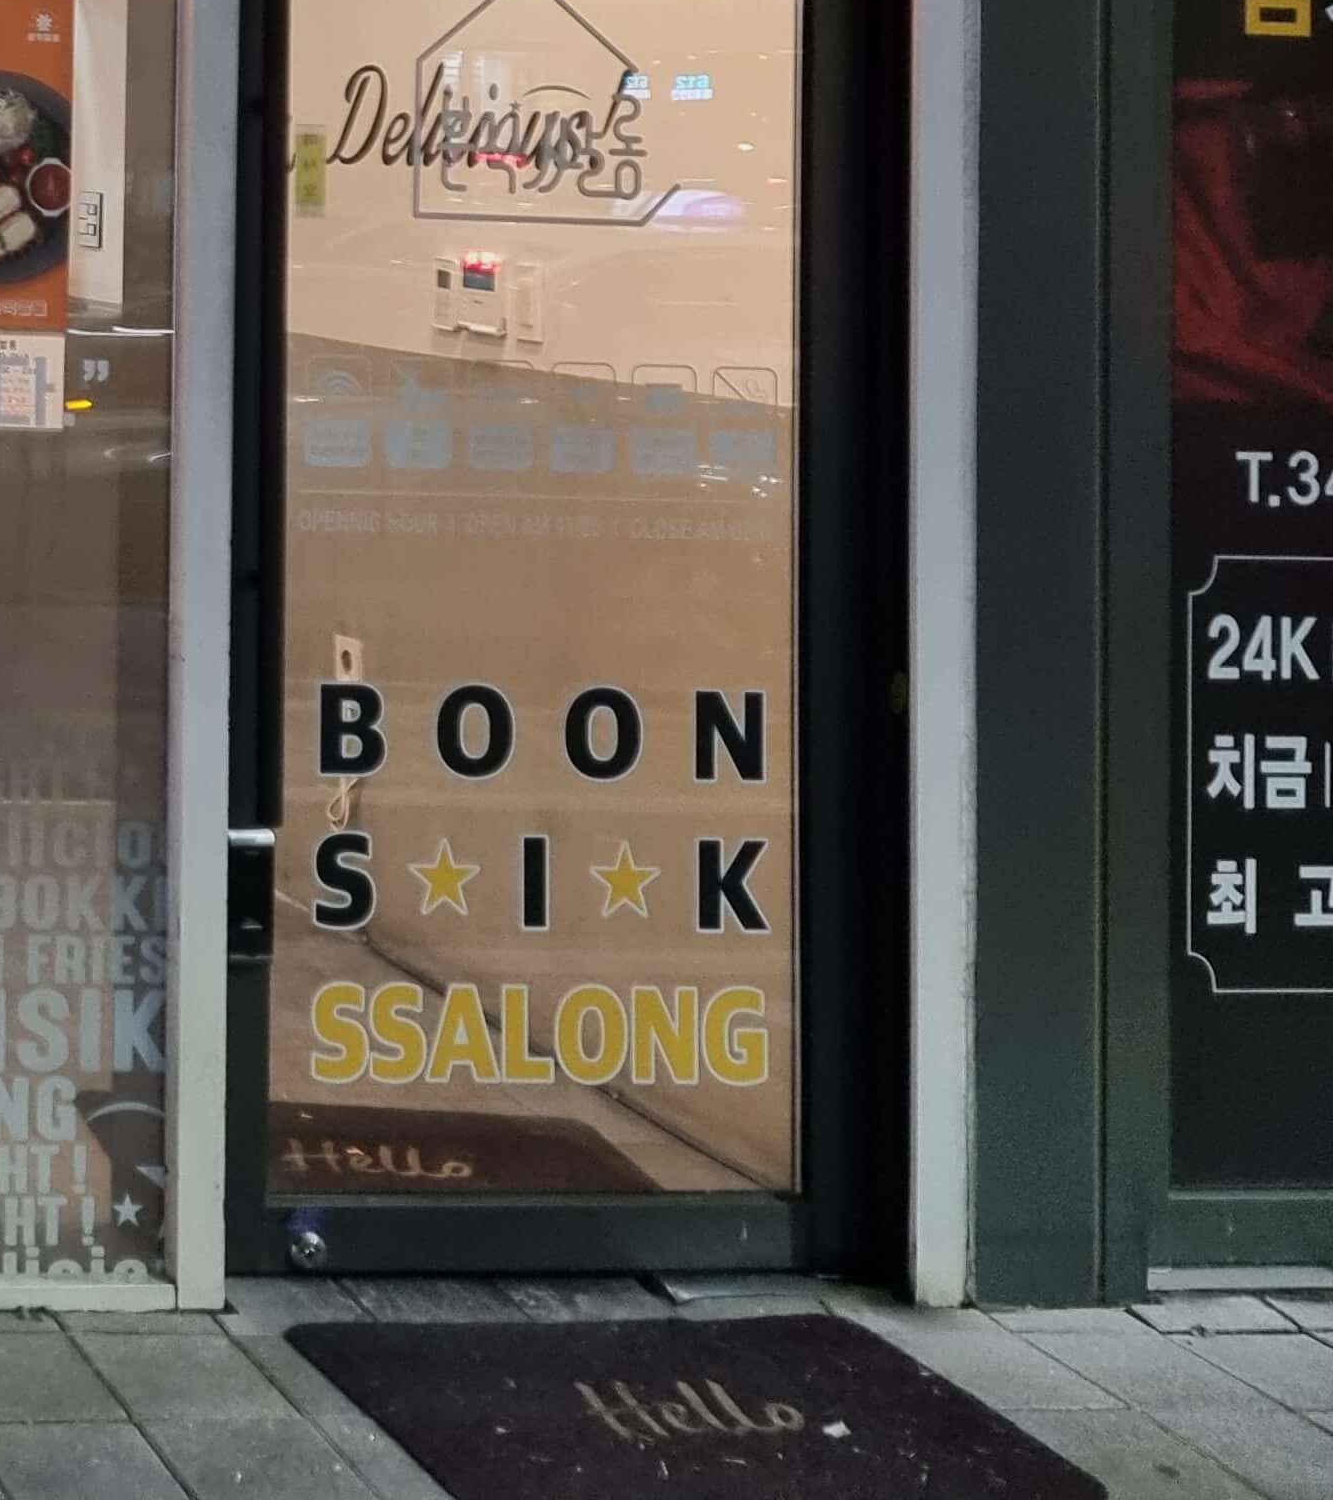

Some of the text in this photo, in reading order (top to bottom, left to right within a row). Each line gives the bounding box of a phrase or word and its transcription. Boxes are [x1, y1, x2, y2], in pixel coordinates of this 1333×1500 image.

[1235, 450, 1333, 507] T.3
[1206, 614, 1320, 682] 24K
[316, 682, 769, 784] BOON
[309, 981, 770, 1087] SSALONG
[573, 1378, 806, 1444] Hello
